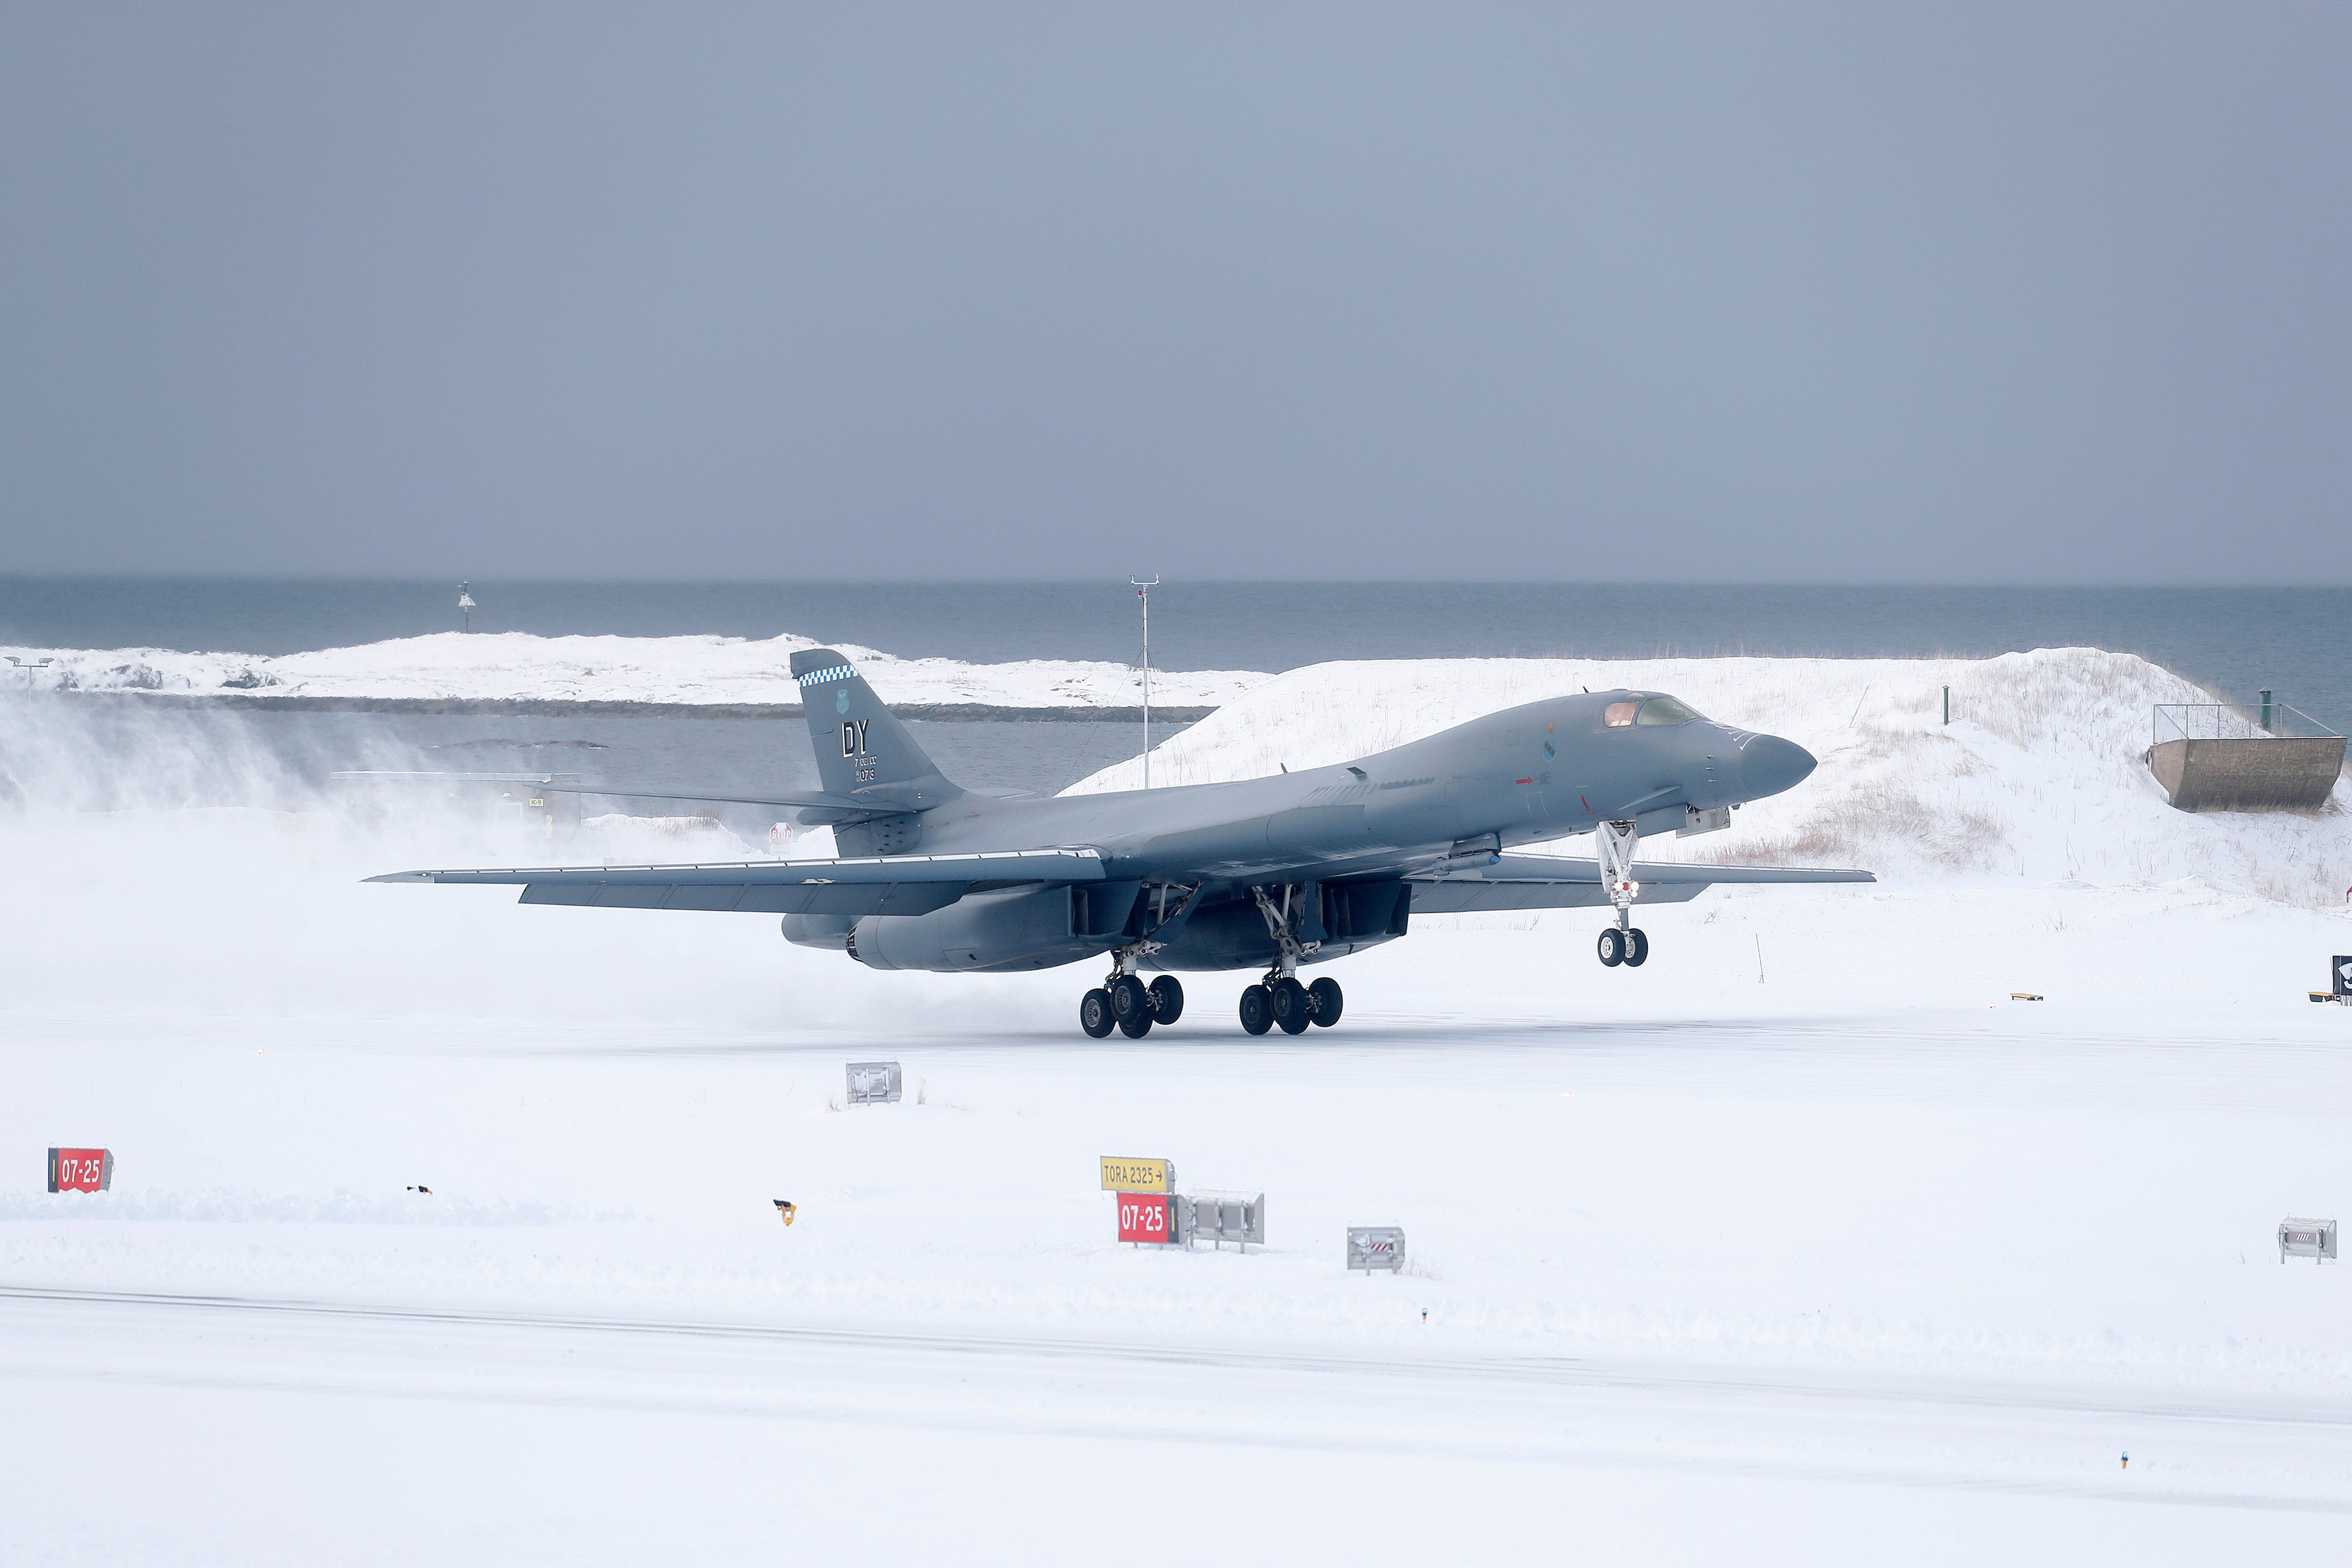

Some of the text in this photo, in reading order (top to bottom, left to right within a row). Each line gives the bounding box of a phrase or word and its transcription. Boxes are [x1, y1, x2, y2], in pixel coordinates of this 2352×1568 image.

[842, 719, 869, 758] DY
[854, 758, 859, 767] 7
[772, 830, 791, 839] STOP
[62, 1159, 100, 1183] 07-25
[1104, 1166, 1153, 1184] TORA 2325
[1122, 1205, 1163, 1231] 07-25
